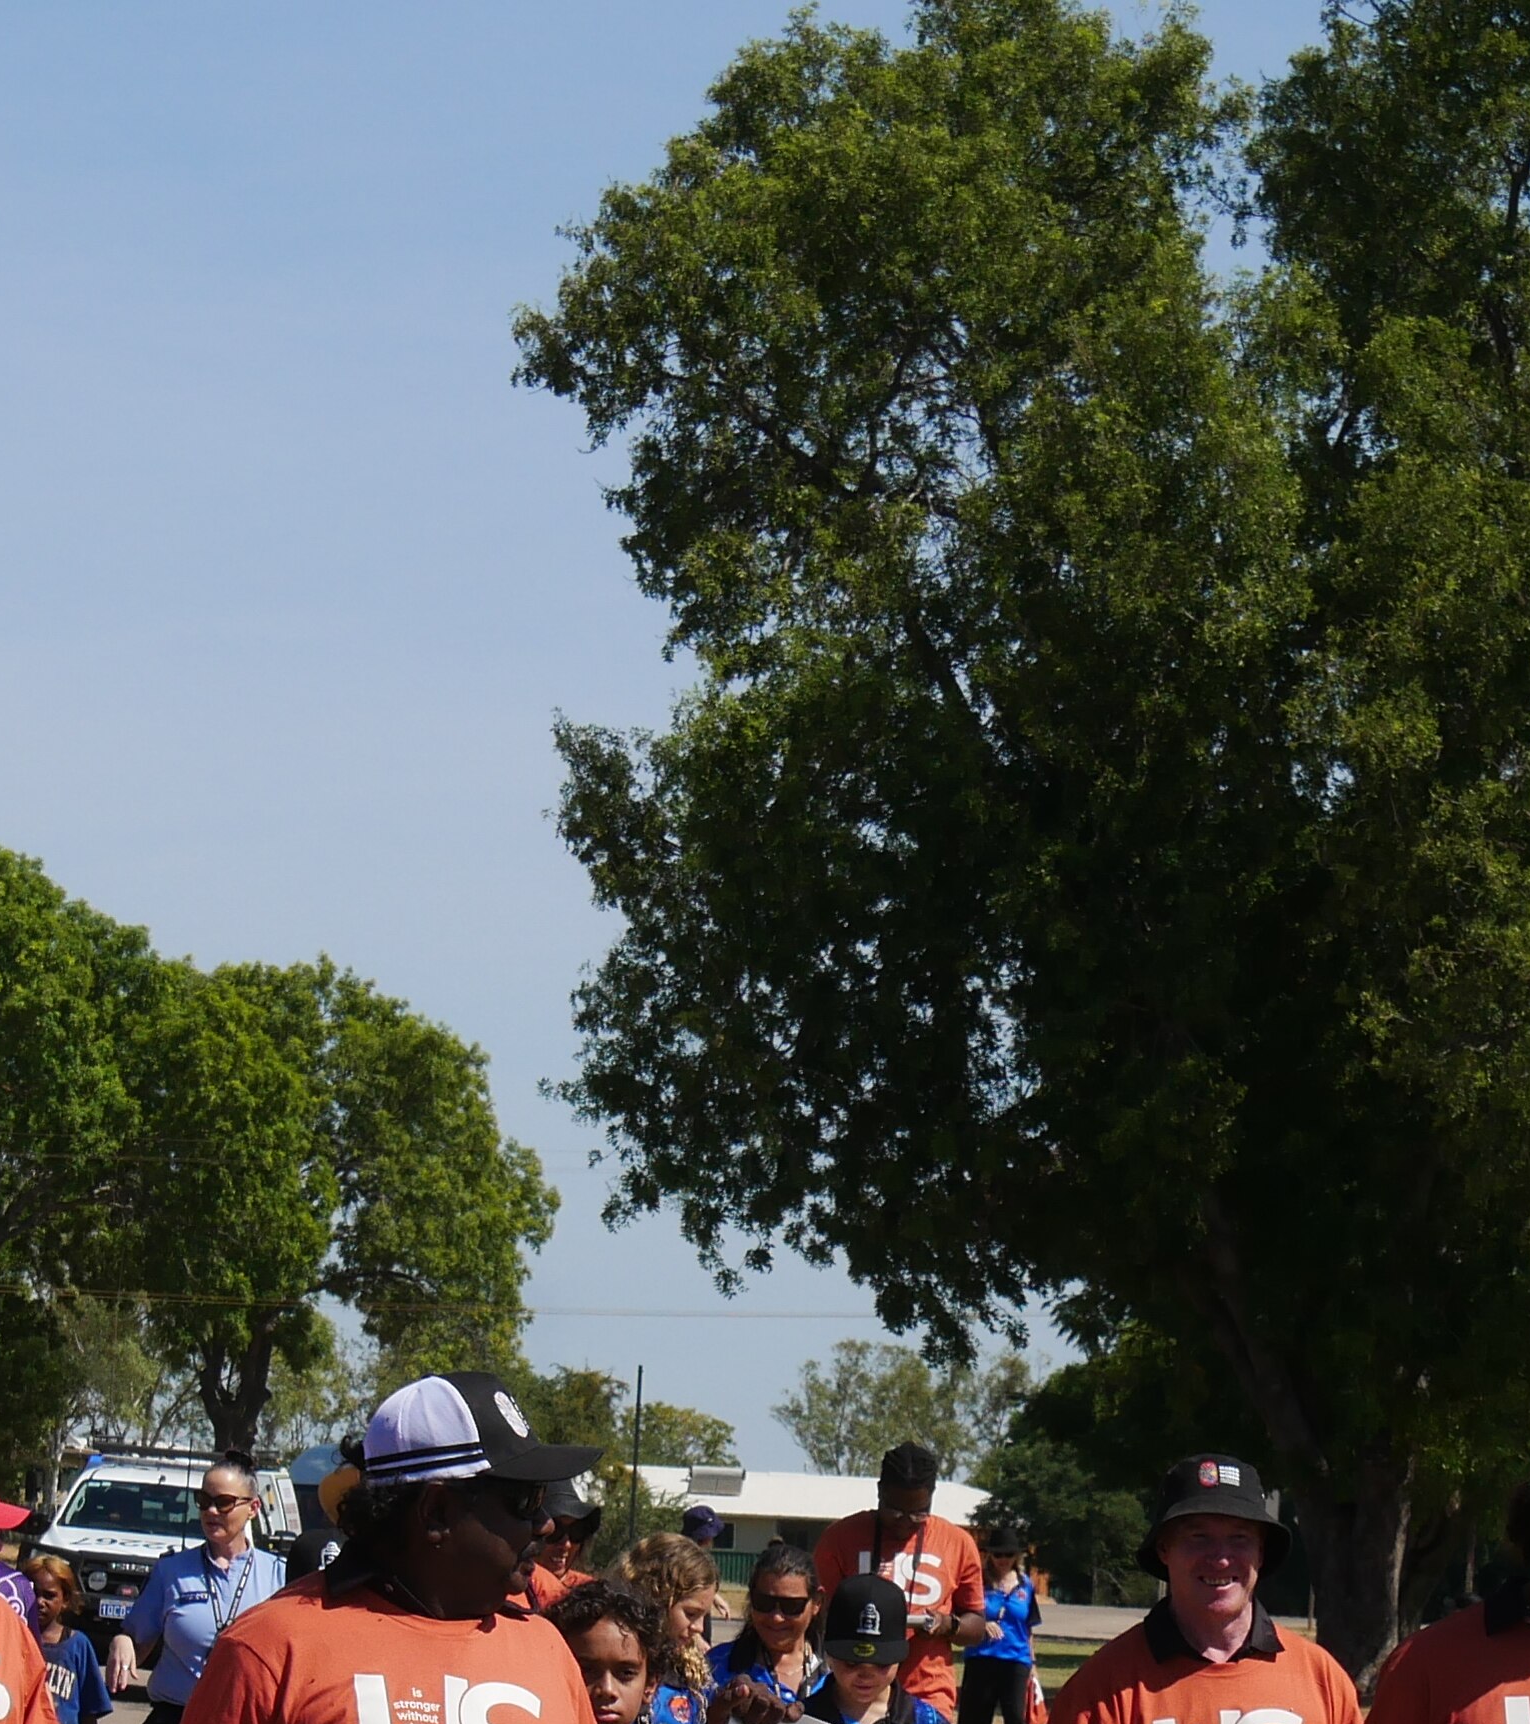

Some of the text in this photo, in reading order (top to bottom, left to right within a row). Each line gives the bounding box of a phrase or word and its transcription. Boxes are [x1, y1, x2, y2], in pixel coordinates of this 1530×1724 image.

[412, 1687, 423, 1698] is
[394, 1700, 441, 1713] stronger
[397, 1711, 440, 1724] without
